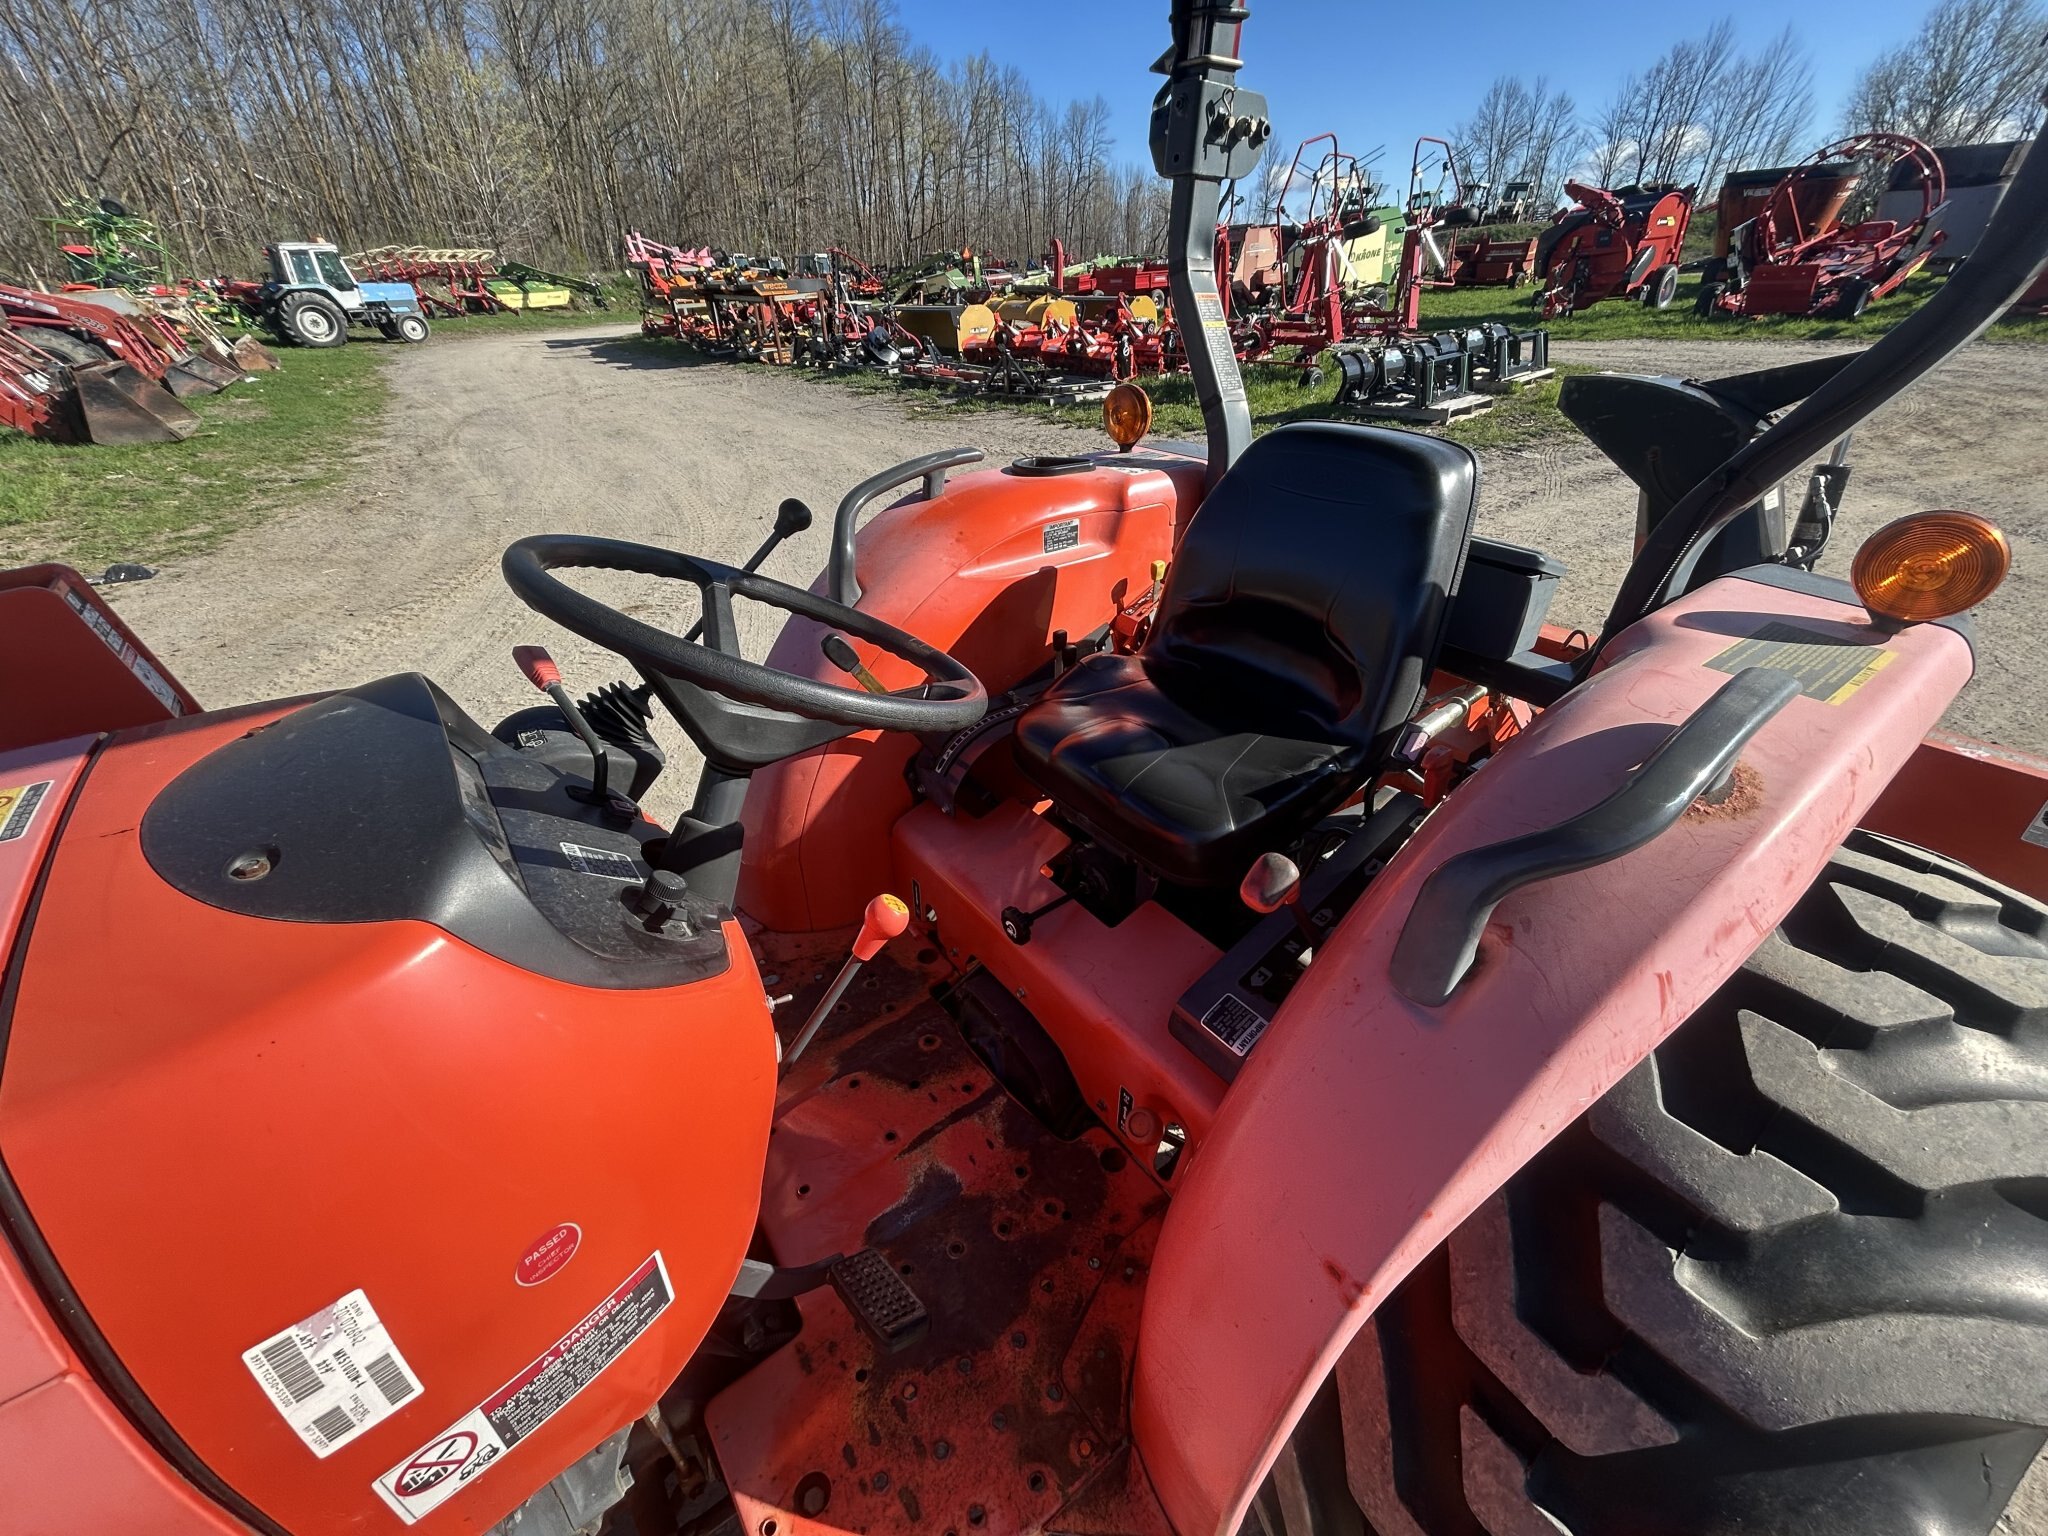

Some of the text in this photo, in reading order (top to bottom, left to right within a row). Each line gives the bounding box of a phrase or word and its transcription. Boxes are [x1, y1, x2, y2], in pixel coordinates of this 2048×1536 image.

[1356, 248, 1382, 262] KRONE
[1236, 1020, 1267, 1053] IMPORTANT
[524, 1228, 569, 1267] PASSED
[529, 1242, 576, 1283] INSPECTOR
[537, 1247, 562, 1269] CHIEF
[641, 1287, 654, 1301] start
[559, 1297, 616, 1351] DANGER
[332, 1347, 367, 1389] MX5100DW-4
[489, 1291, 633, 1418] TO AVOID POSSIBLE INJURY OR DEATH
[491, 1399, 515, 1422] FROM
[528, 1360, 562, 1392] MACHINE
[503, 1404, 516, 1416] Do
[518, 1393, 530, 1405] not
[533, 1377, 549, 1393] start
[552, 1355, 575, 1377] engine
[537, 1374, 567, 1401] Machine
[576, 1368, 591, 1383] PTO
